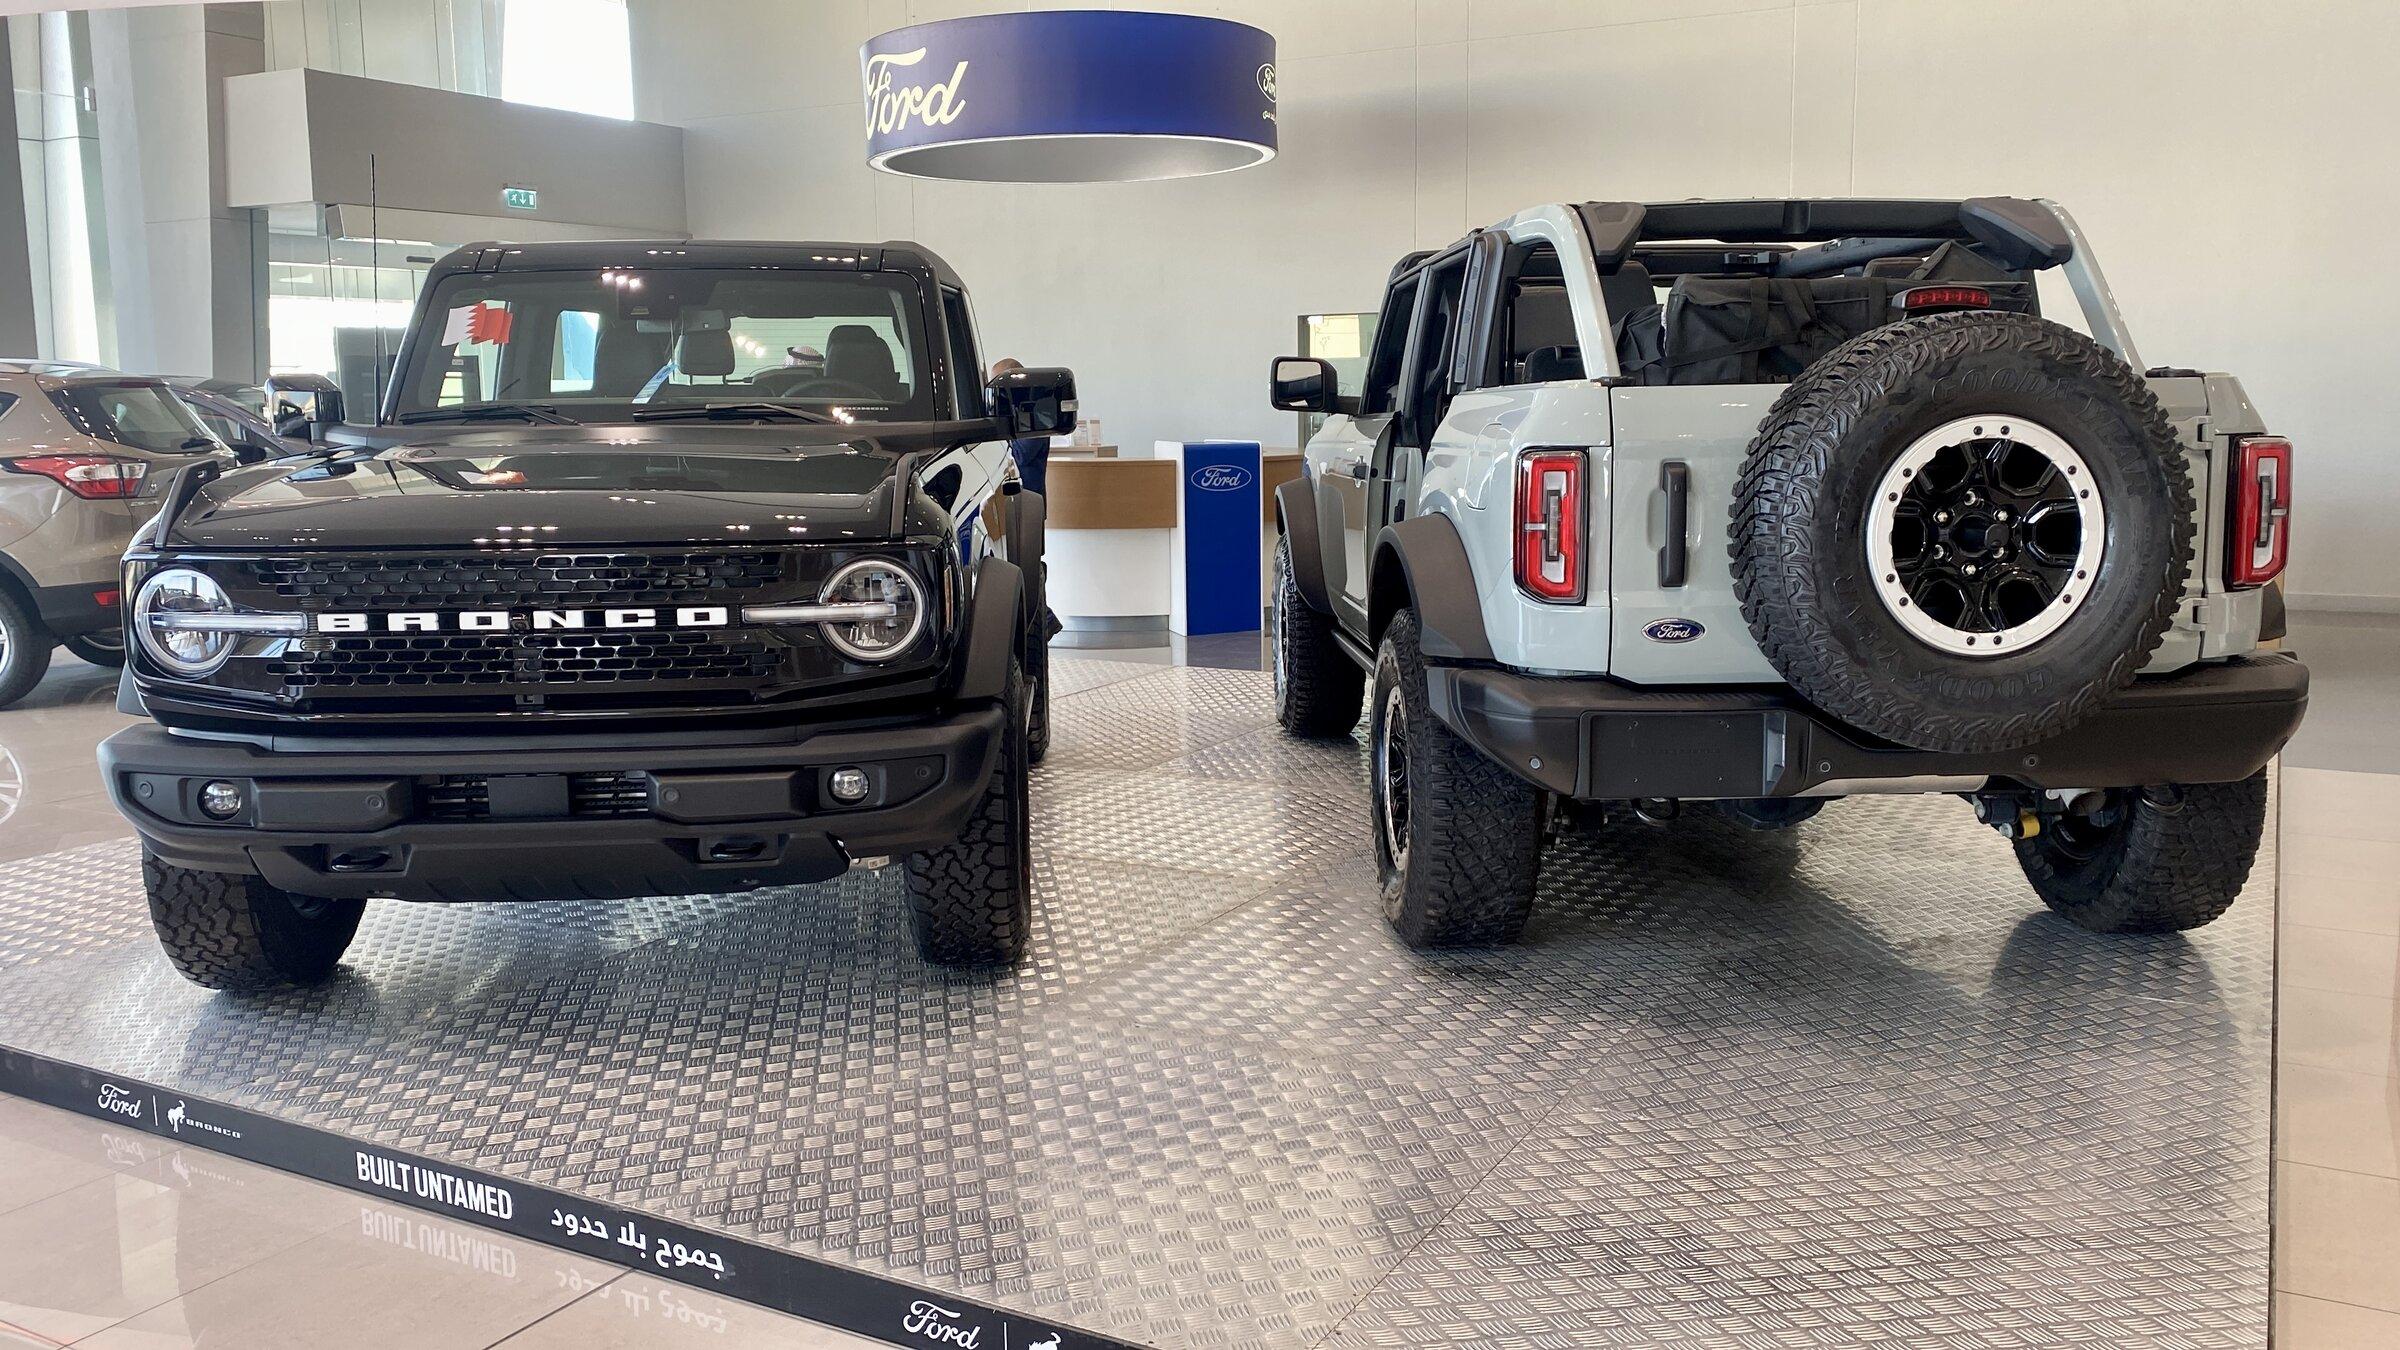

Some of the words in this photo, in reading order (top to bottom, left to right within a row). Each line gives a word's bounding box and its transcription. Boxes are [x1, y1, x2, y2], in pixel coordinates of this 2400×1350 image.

[866, 47, 968, 140] Ford
[1201, 467, 1241, 487] Ford
[316, 607, 729, 633] BRONCO
[1657, 624, 1691, 638] Ford
[98, 1083, 141, 1118] Ford
[186, 1117, 241, 1139] BRONCO
[356, 1151, 410, 1192] BUILT
[413, 1166, 513, 1220] UNTAMED
[551, 1208, 609, 1239] حدود
[617, 1221, 647, 1259] بلا
[655, 1238, 725, 1280] جموح
[902, 1300, 981, 1350] Ford
